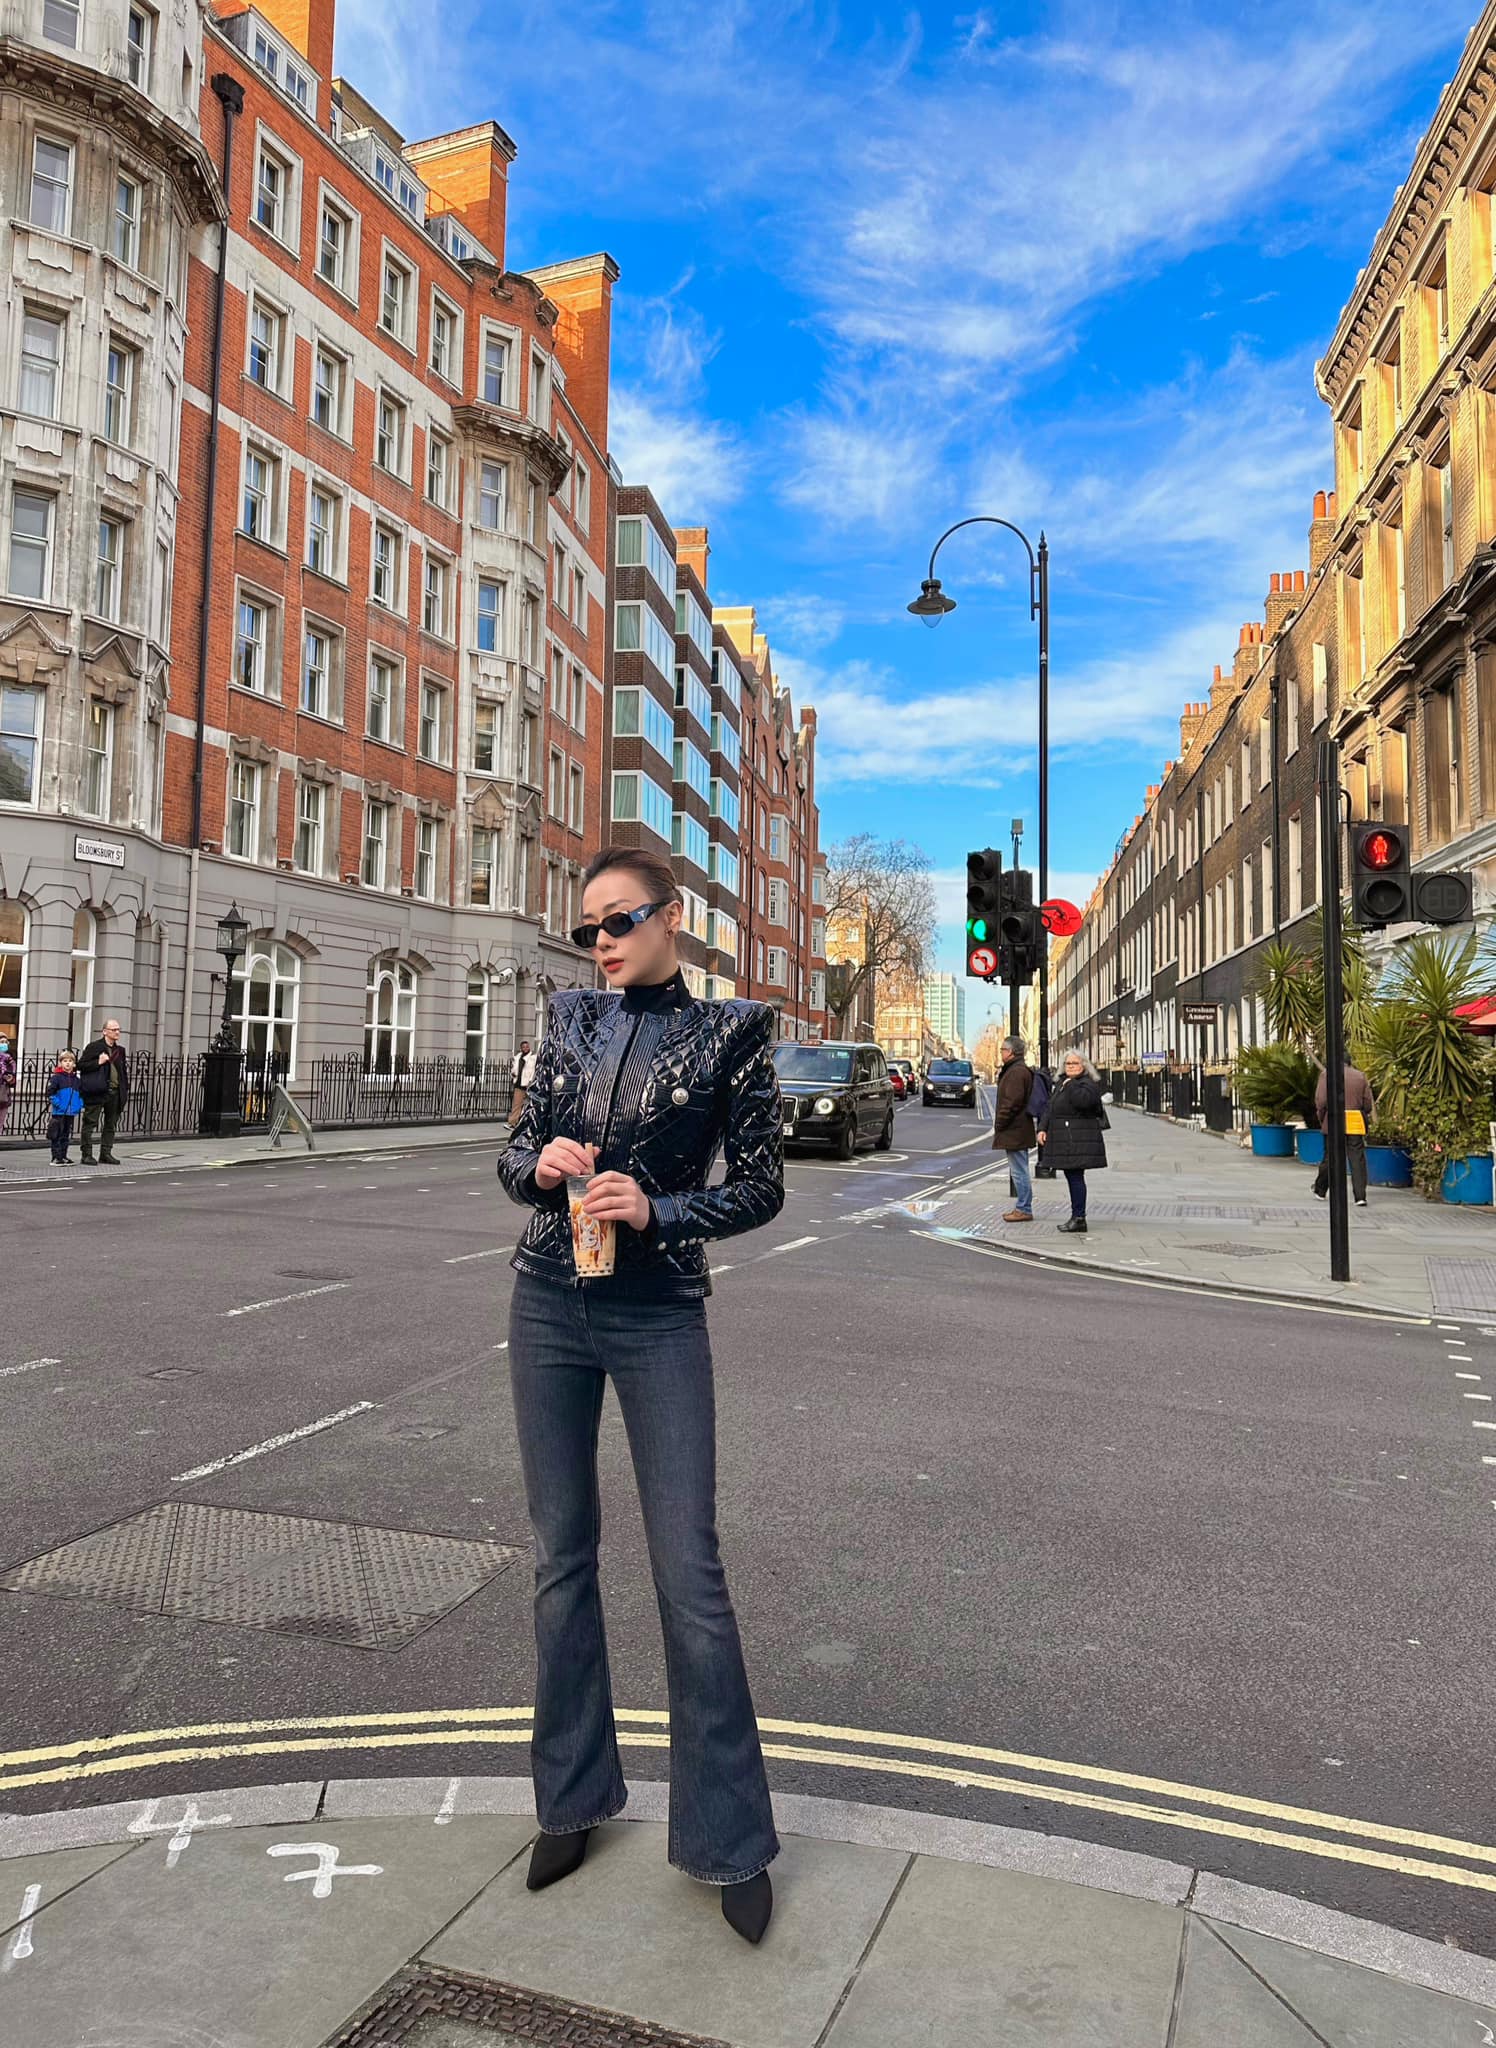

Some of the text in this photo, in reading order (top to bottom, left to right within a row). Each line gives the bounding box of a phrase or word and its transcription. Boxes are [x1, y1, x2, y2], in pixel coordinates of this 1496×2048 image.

[78, 843, 114, 859] BLOOMSBURY
[437, 1989, 607, 2046] POST OFFICE
